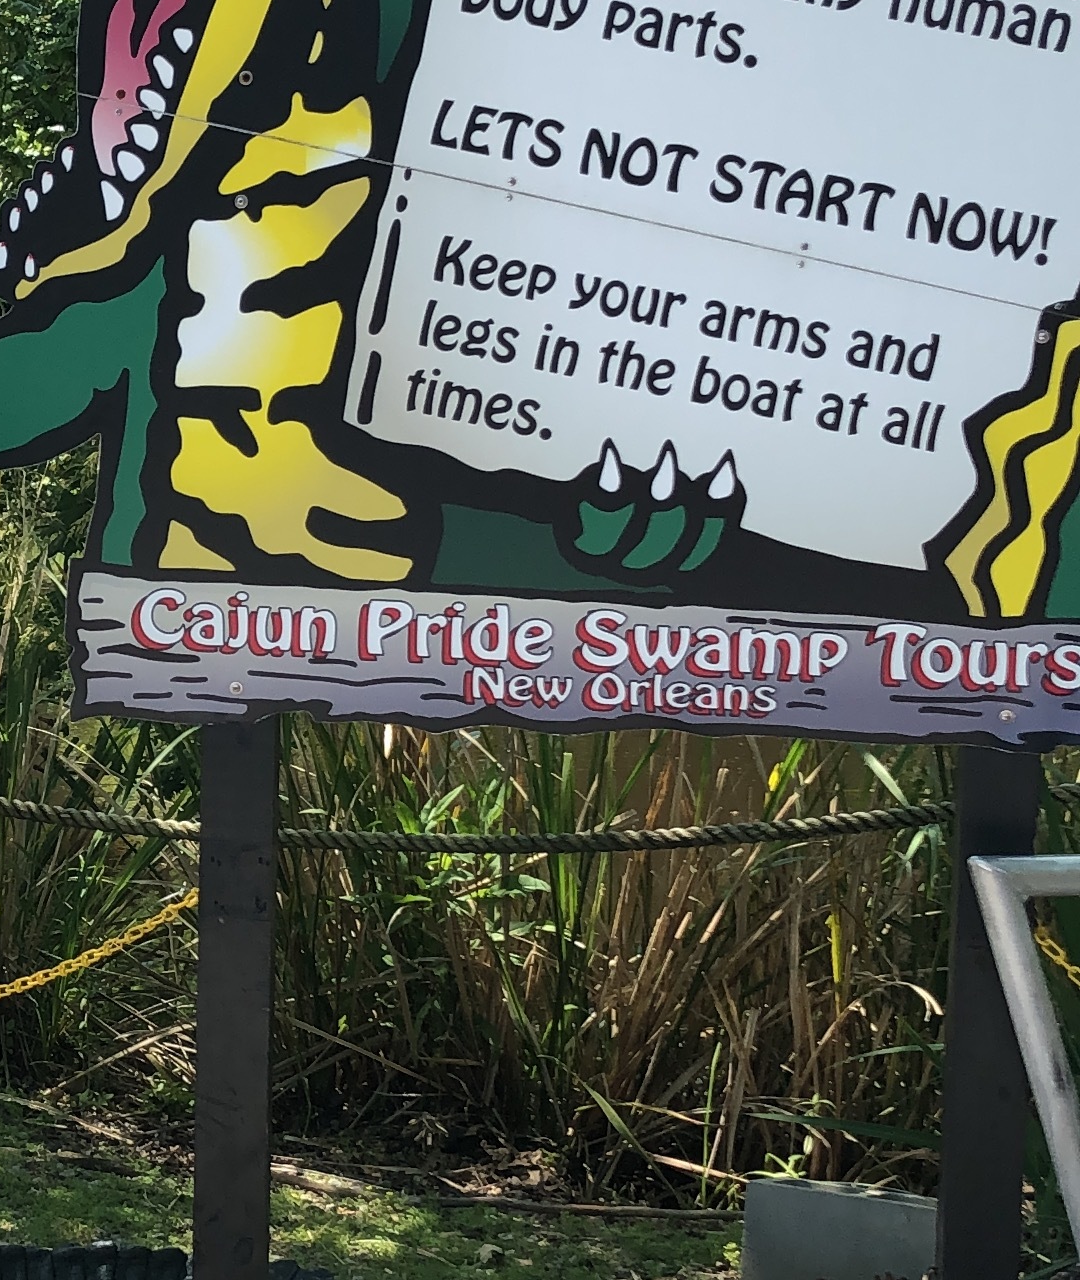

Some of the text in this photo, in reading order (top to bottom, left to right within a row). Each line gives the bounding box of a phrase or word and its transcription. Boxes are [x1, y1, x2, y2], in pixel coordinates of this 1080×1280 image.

[603, 1, 757, 68] parts.
[431, 100, 1057, 265] LETS NOT START NOW!
[434, 236, 939, 381] Keep your arms and
[407, 370, 551, 440] times.
[419, 300, 945, 452] legs in the boat at all
[131, 588, 1080, 696] Cajun Pride Swamp Tours
[463, 666, 778, 718] New Orleans
